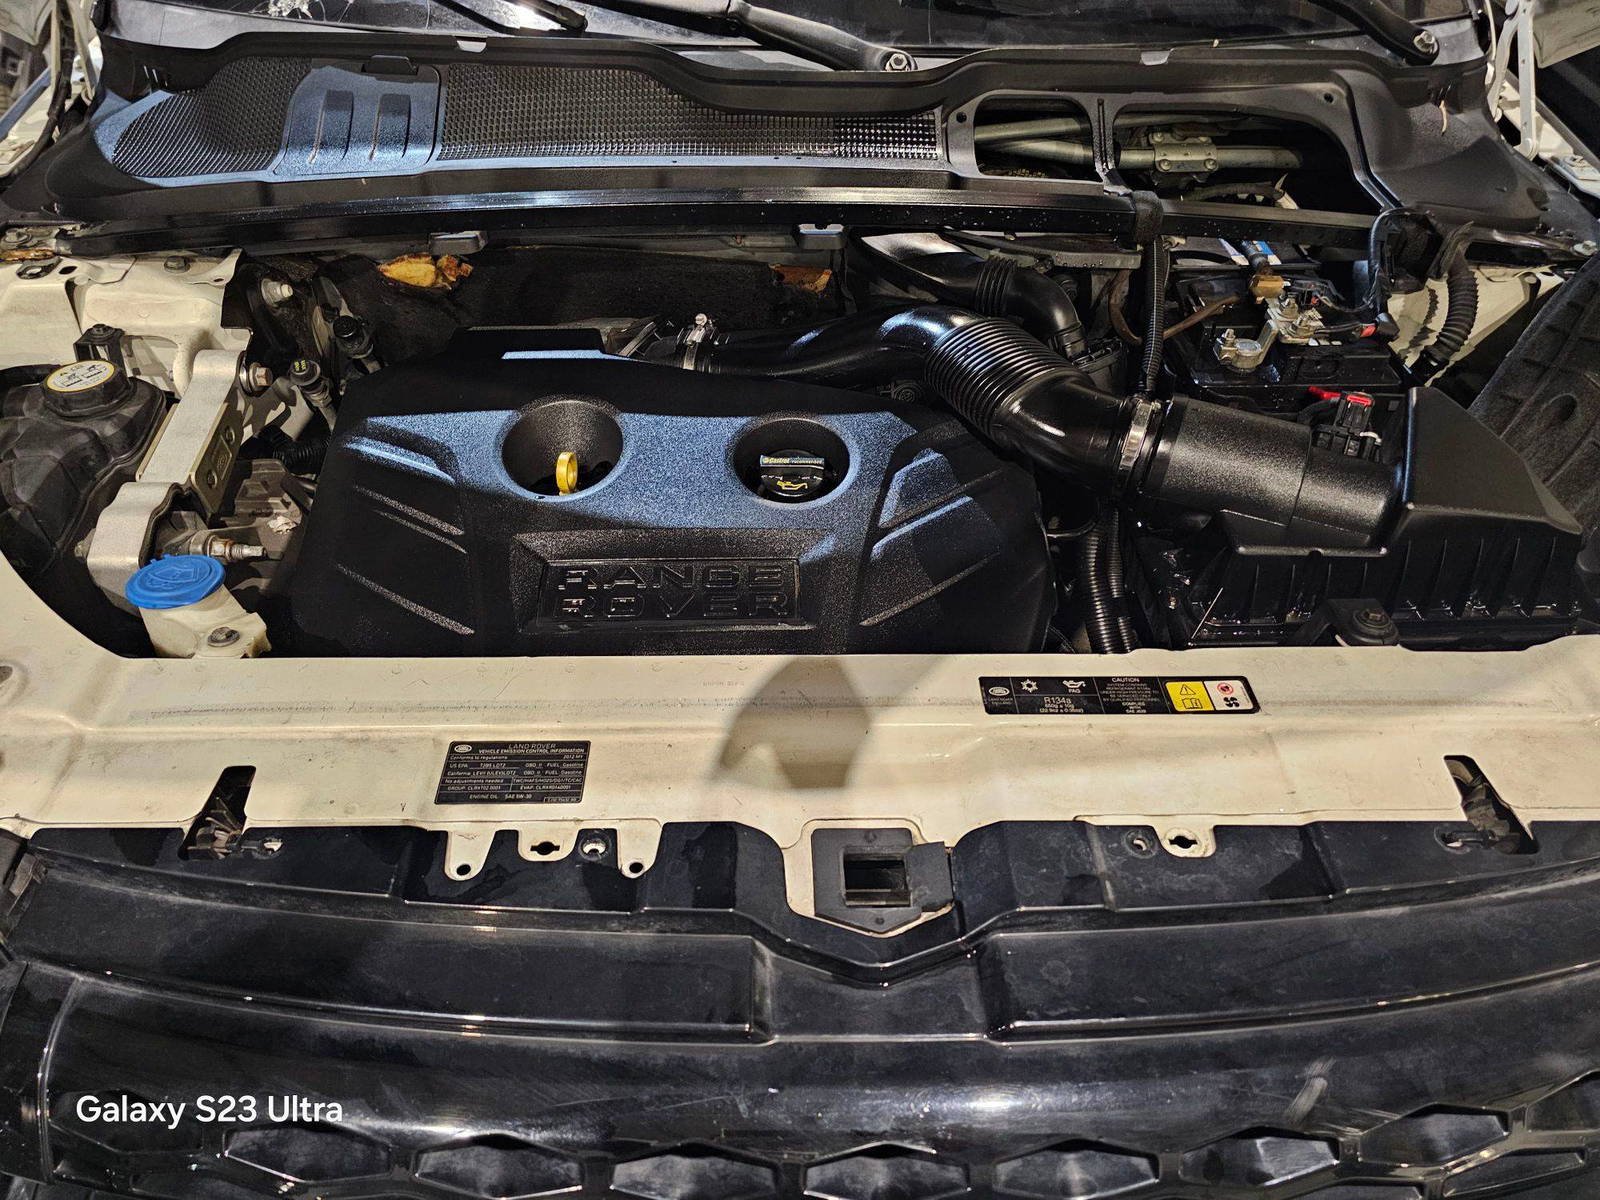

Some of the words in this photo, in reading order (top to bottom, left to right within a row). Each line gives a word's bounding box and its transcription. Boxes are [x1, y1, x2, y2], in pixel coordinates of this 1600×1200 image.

[557, 564, 784, 590] RANGE
[553, 592, 788, 618] ROVER
[1043, 696, 1072, 704] R134a
